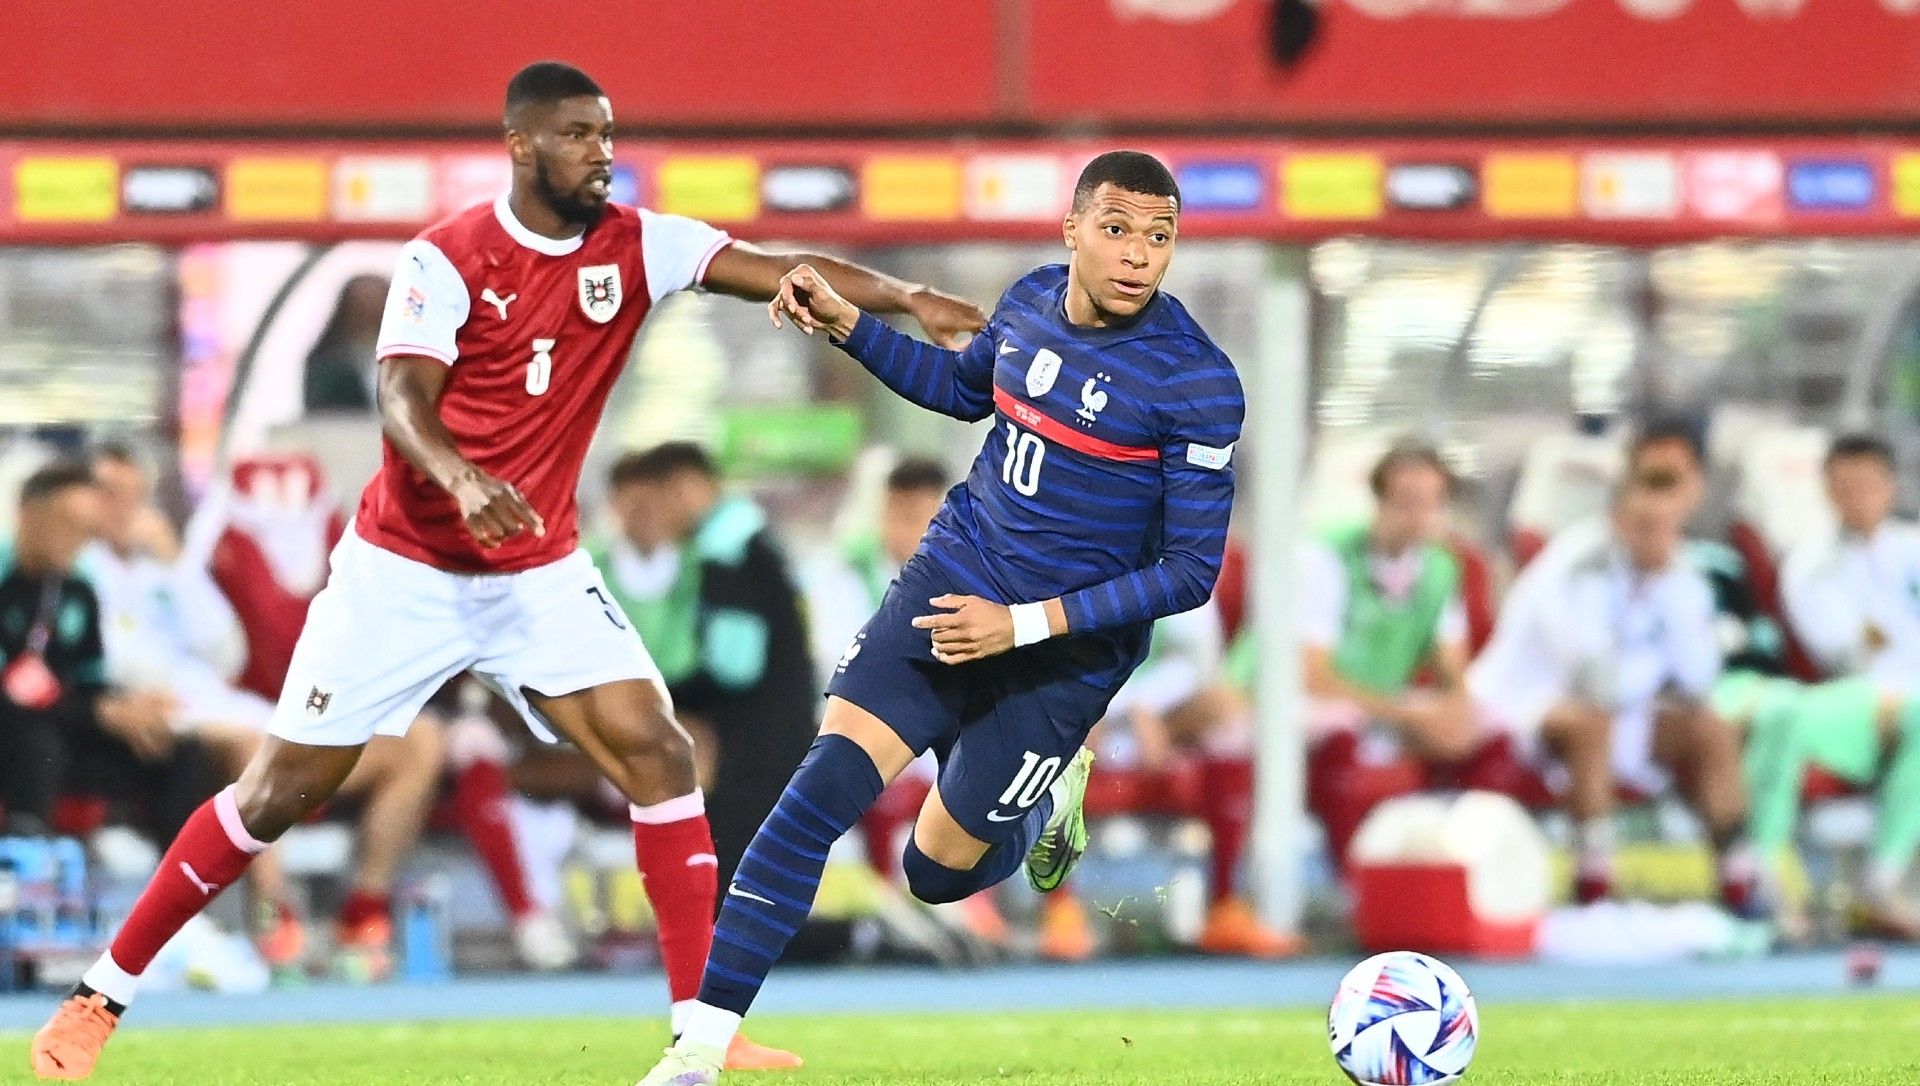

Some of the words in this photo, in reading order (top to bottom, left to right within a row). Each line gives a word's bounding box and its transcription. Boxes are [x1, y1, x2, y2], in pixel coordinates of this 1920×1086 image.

[525, 338, 556, 396] 3
[1003, 421, 1046, 497] 10
[998, 750, 1061, 808] 10
